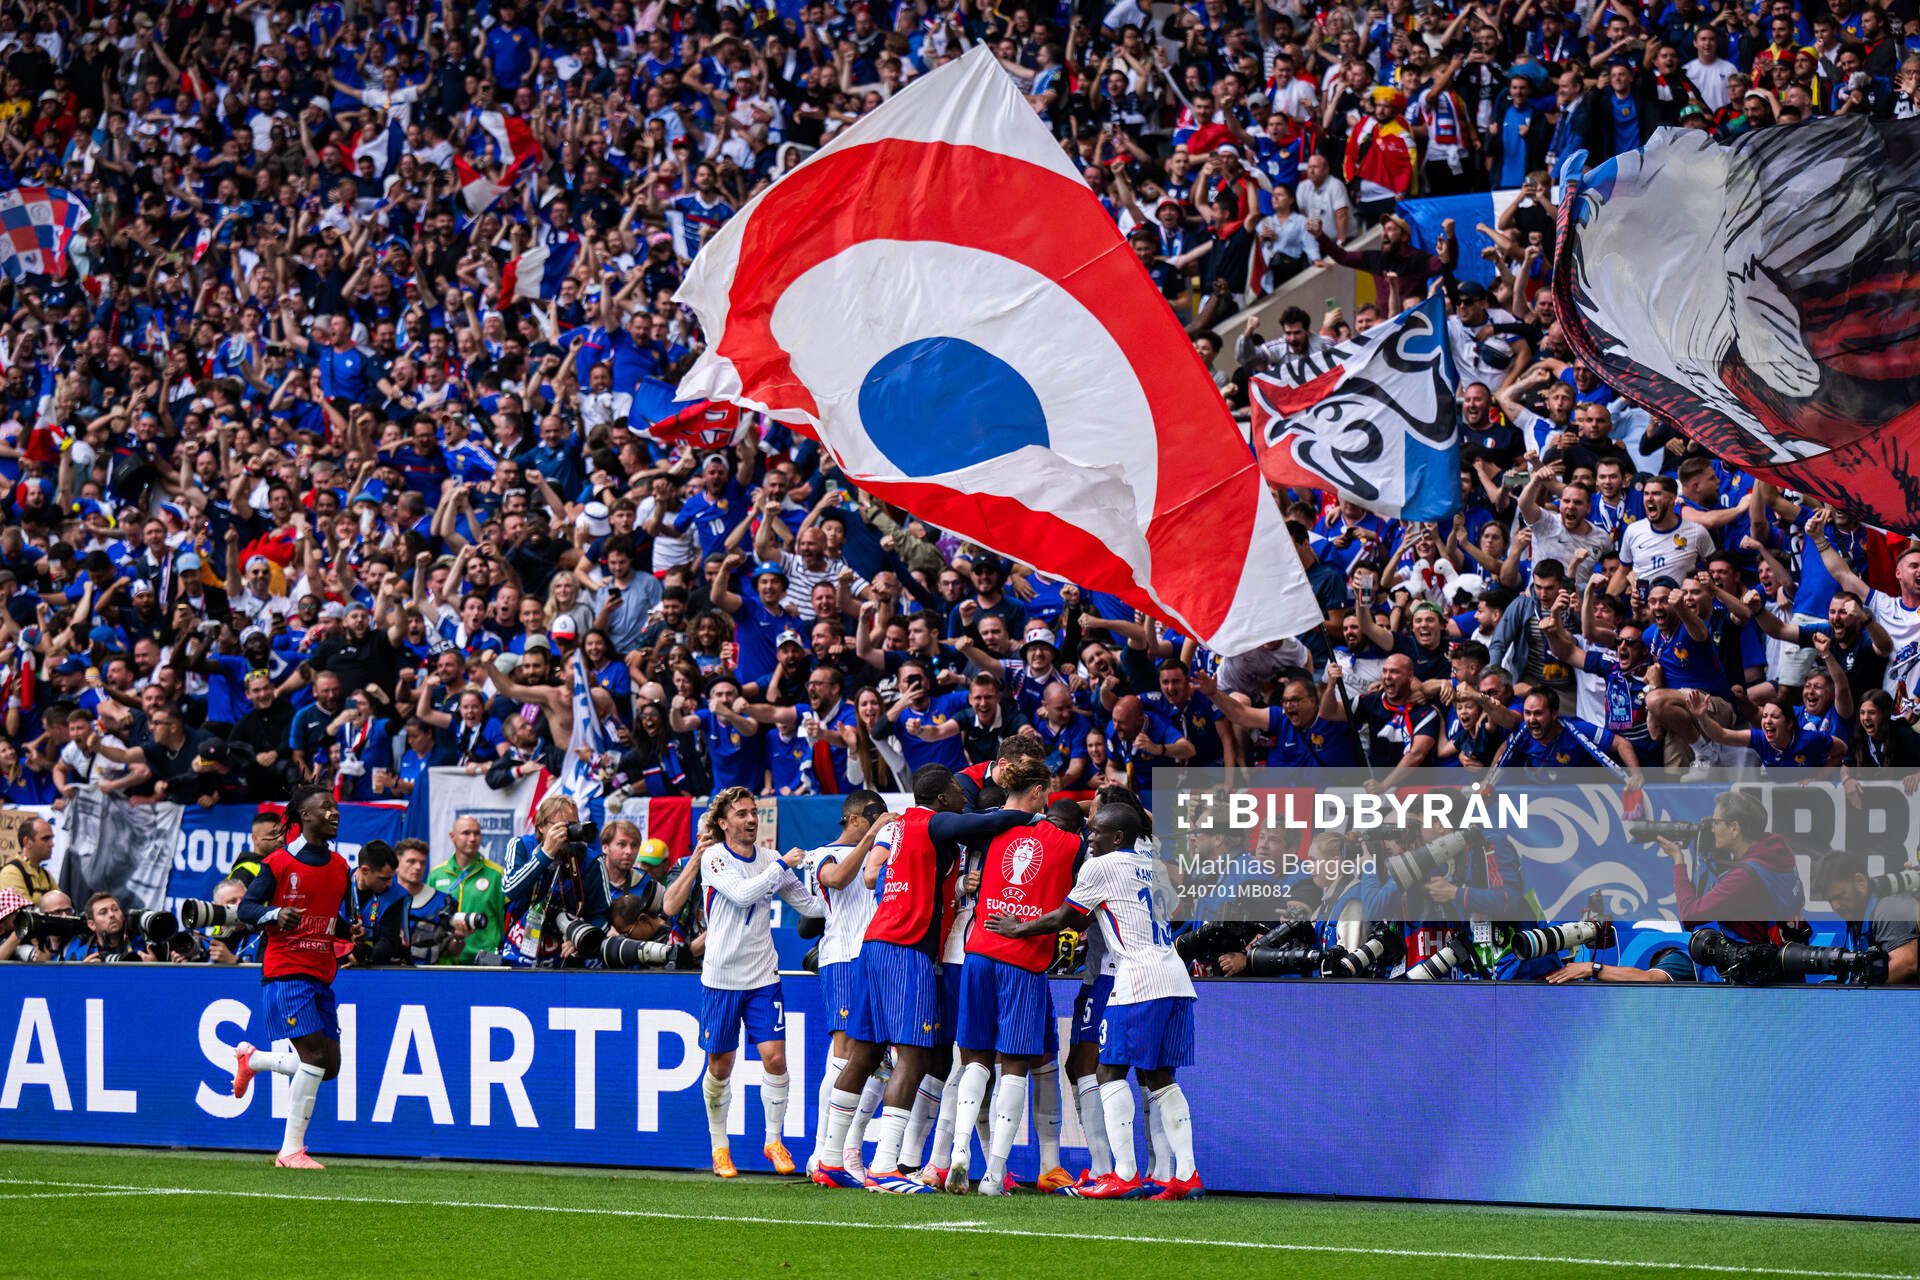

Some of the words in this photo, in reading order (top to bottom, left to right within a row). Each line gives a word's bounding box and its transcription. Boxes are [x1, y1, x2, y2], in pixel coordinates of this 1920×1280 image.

[708, 518, 725, 536] 10
[1002, 888, 1024, 901] UEFA
[986, 898, 1043, 917] EURO2024
[773, 1001, 783, 1025] 7
[1083, 997, 1094, 1024] 5
[0, 997, 137, 1113] AL
